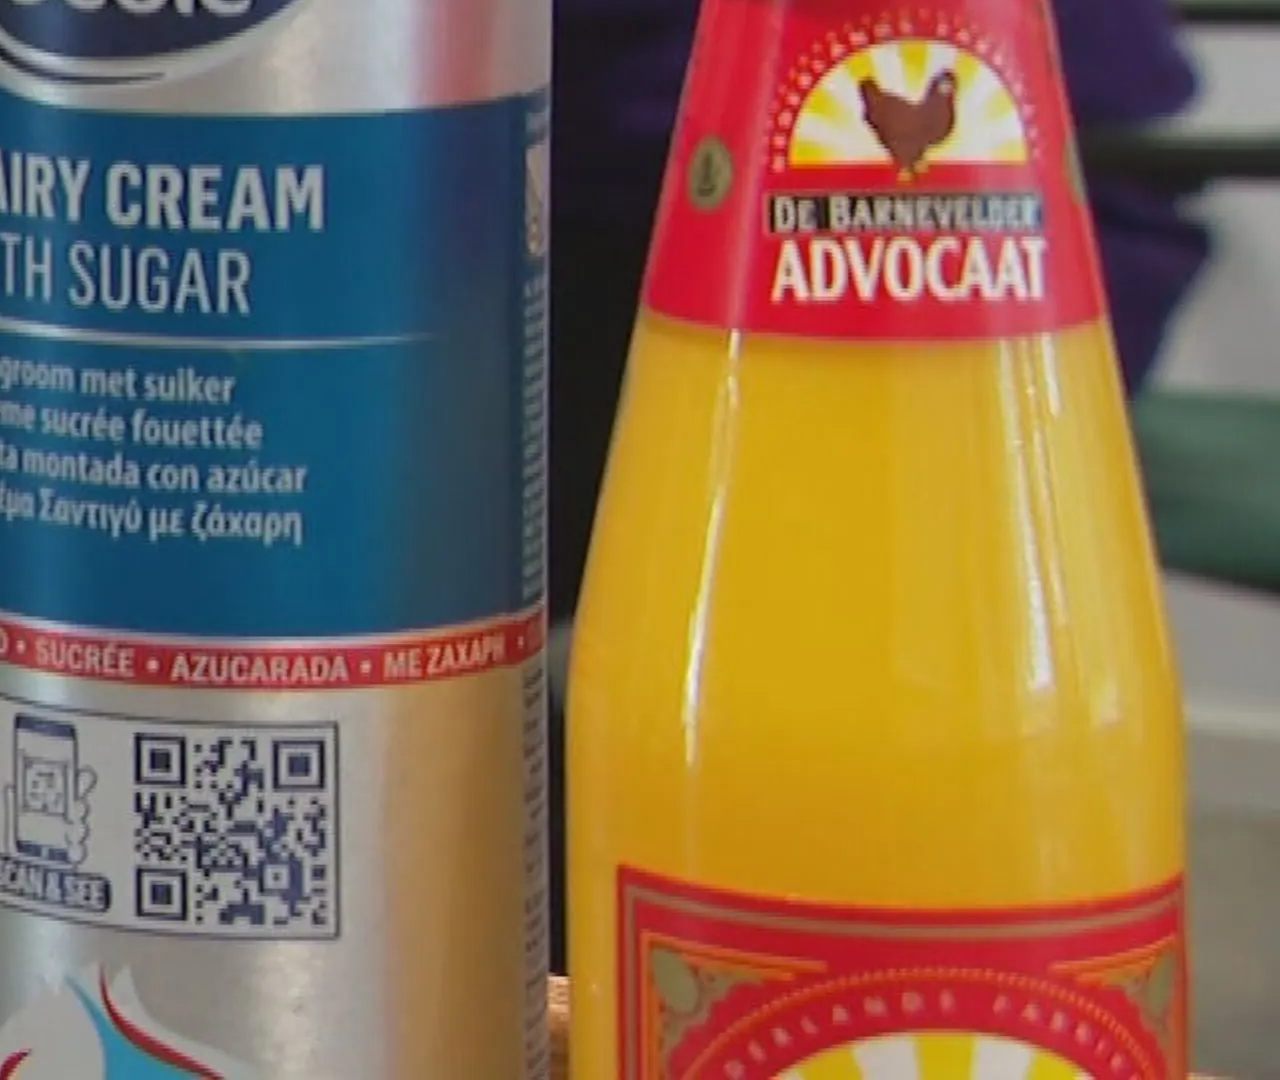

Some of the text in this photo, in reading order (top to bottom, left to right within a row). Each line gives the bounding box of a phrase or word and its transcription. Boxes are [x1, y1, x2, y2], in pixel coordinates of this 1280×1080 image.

[106, 163, 326, 232] CREAM
[774, 193, 1040, 233] DE BARNEVELDER
[68, 242, 251, 315] SUGAR
[771, 236, 1049, 303] ADVOCAAT
[81, 367, 136, 399] met
[143, 366, 236, 405] suiker
[42, 407, 125, 443] sucrée
[133, 408, 264, 450] fouettée
[23, 448, 140, 490] montada
[147, 463, 200, 493] con
[206, 456, 307, 494] azúcar
[148, 507, 184, 544] με
[191, 499, 303, 547] ζάχαρη
[35, 635, 137, 678] SUCRÉE
[170, 652, 351, 684] AZUCARADA
[63, 875, 106, 910] SEE
